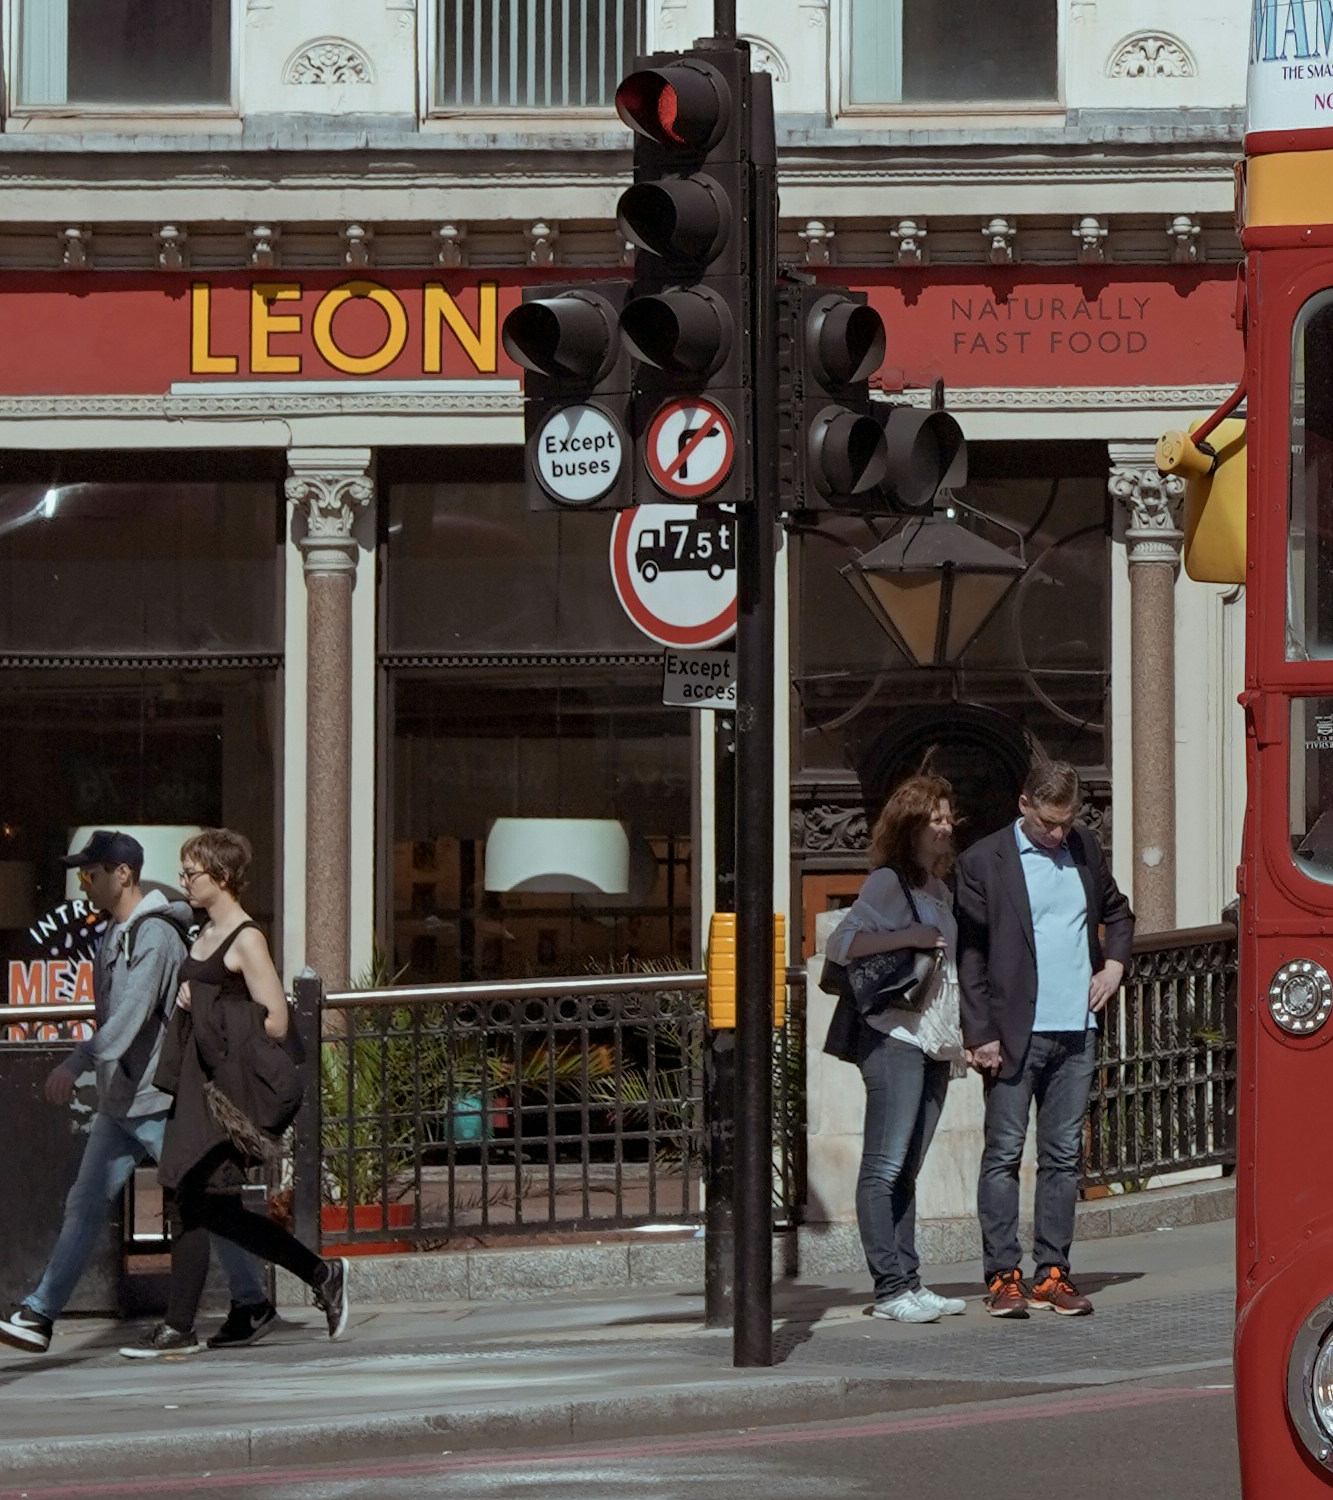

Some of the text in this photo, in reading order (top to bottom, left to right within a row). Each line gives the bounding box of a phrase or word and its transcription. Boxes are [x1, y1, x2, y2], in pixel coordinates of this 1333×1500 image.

[1281, 65, 1304, 81] THE
[951, 297, 1151, 321] NATURALLY
[190, 279, 499, 375] LEON
[953, 330, 1148, 355] FAST FOOD
[546, 430, 616, 455] Except
[552, 457, 611, 479] buses
[666, 655, 731, 679] Except
